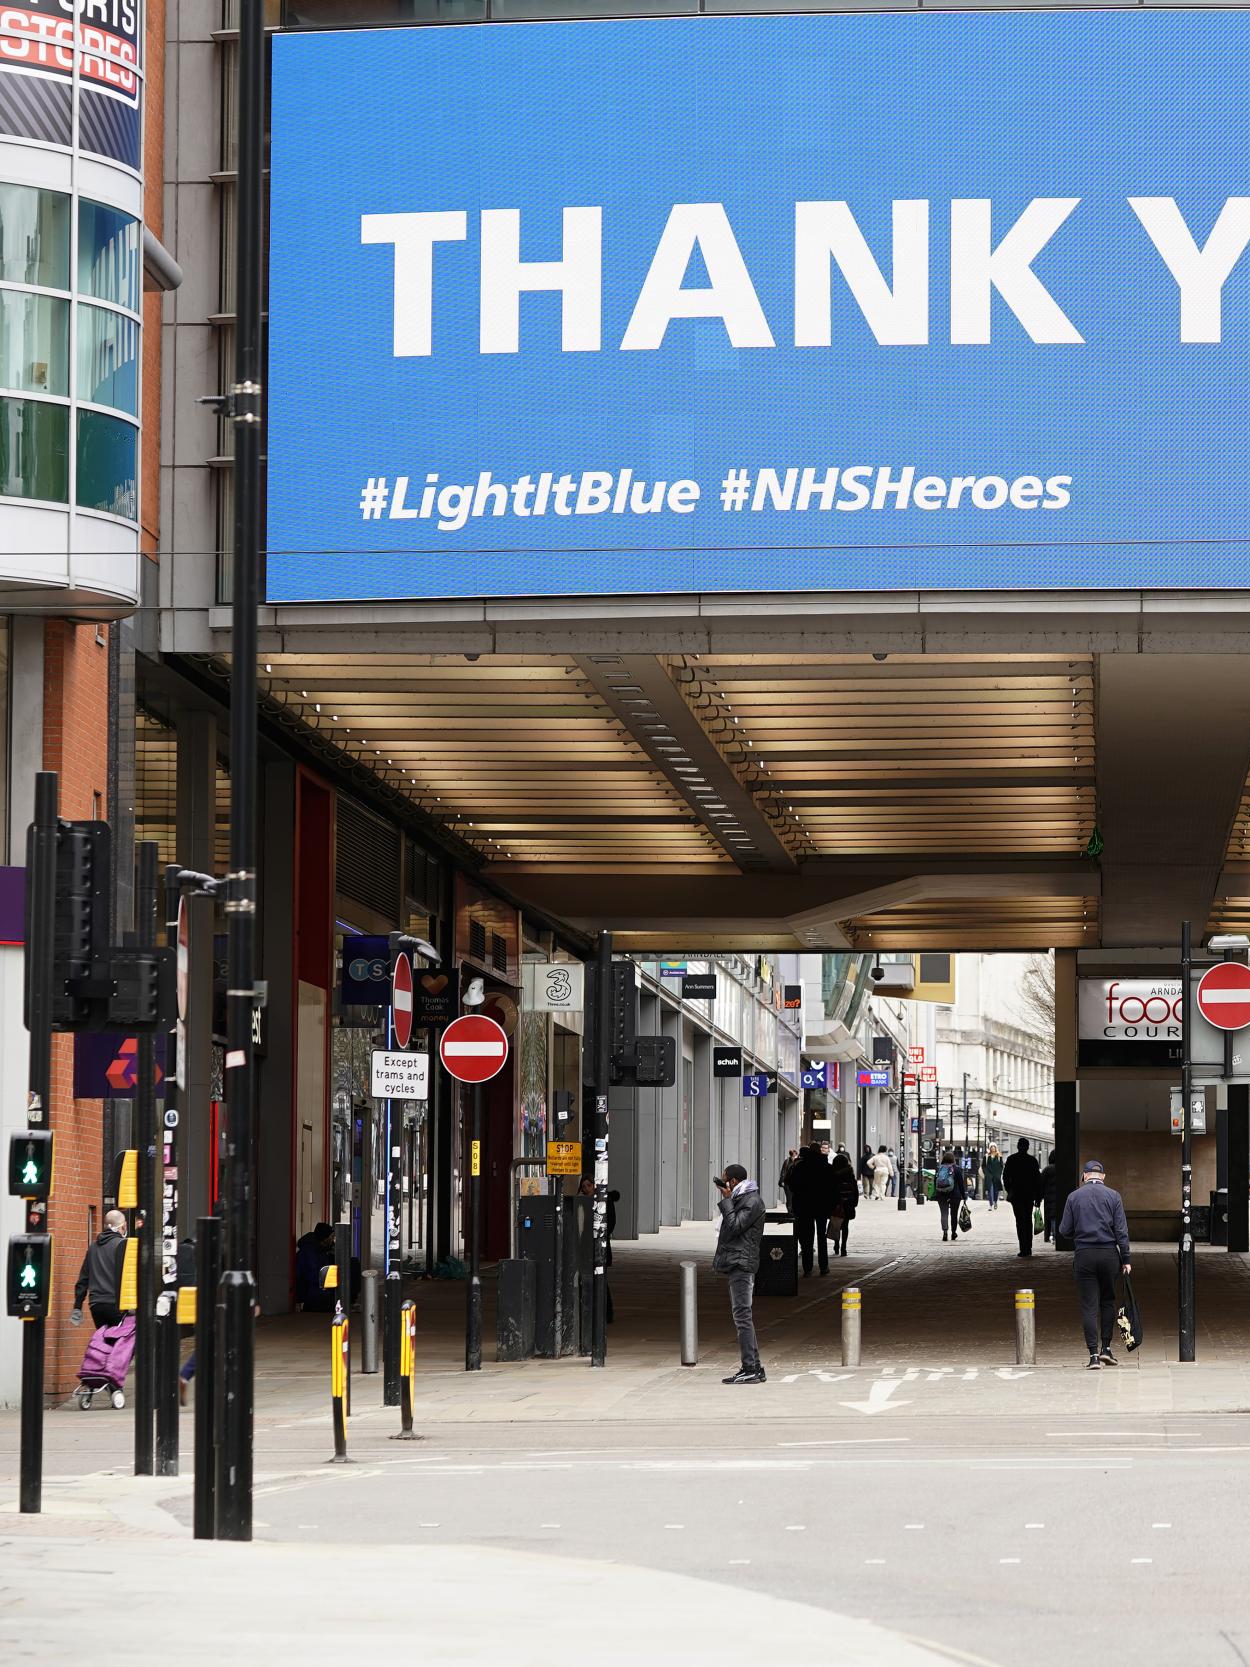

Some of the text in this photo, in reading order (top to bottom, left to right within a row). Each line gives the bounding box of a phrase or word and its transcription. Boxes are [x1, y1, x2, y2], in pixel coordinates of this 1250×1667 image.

[0, 10, 134, 89] STORES
[361, 197, 1086, 357] THANK
[360, 465, 1073, 531] #LightItBlue #NHSHeroes
[420, 995, 449, 1004] Thomas
[425, 1003, 444, 1011] Cook
[420, 1015, 449, 1023] money
[384, 1056, 417, 1069] Except
[375, 1069, 425, 1081] trams and
[384, 1083, 415, 1094] cycles
[556, 1144, 574, 1153] STOP
